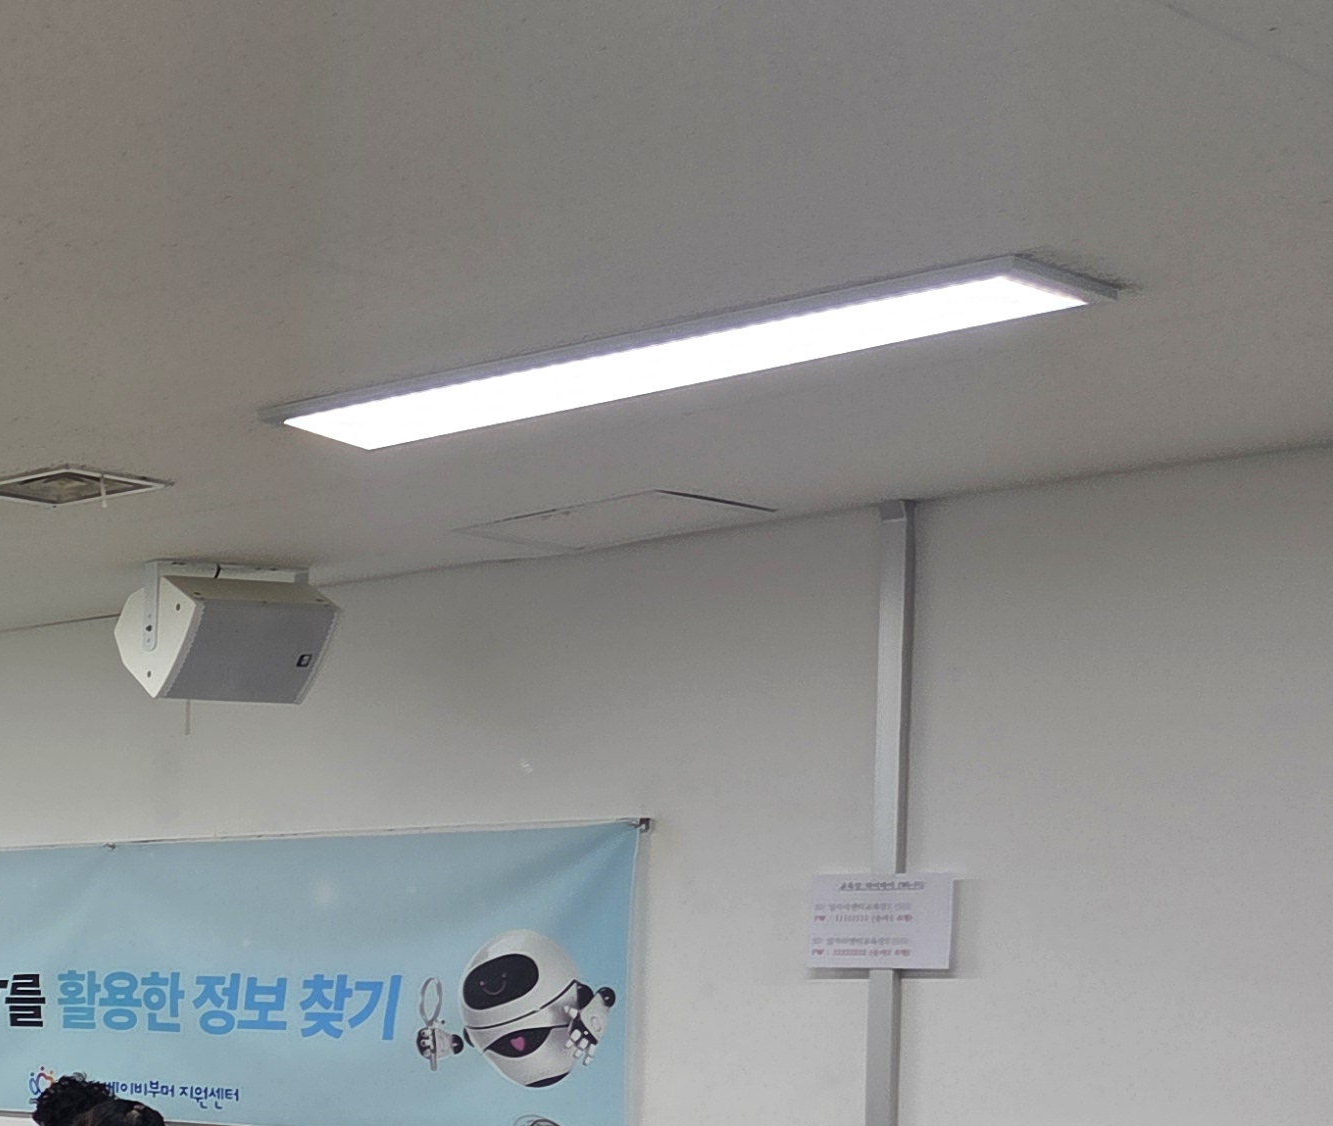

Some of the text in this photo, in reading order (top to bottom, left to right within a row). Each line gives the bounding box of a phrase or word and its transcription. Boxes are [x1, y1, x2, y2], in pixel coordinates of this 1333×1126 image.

[57, 969, 185, 1033] 활용한
[193, 971, 290, 1036] 정보
[297, 973, 404, 1041] 찾기
[179, 1086, 239, 1110] 지원센터
